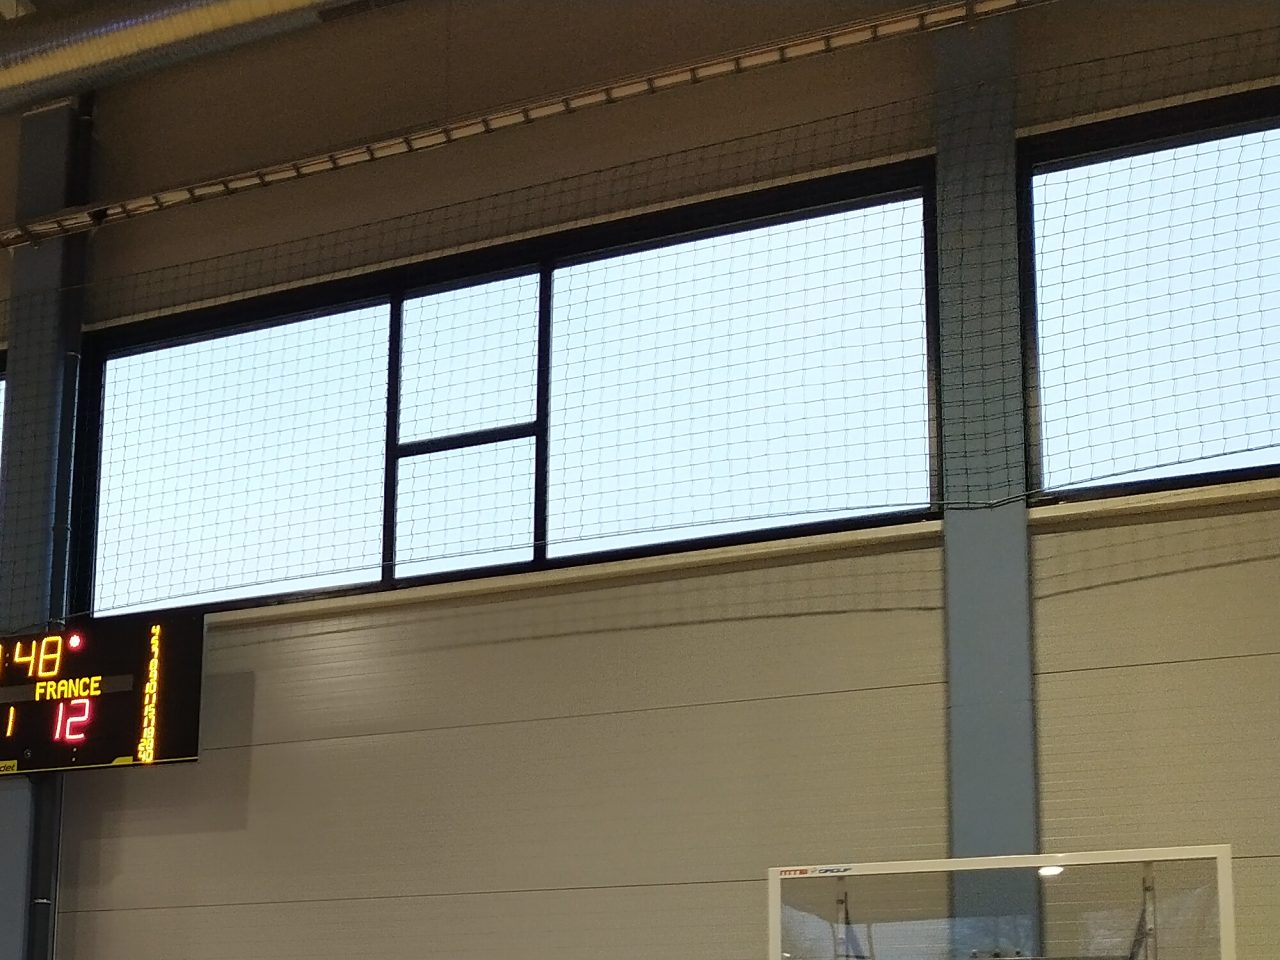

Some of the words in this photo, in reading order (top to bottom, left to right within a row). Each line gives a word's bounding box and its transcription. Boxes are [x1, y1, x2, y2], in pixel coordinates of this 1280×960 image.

[151, 625, 161, 636] 4
[34, 676, 103, 701] FRANCE
[145, 682, 157, 694] 10
[144, 693, 156, 705] 11
[144, 704, 156, 716] 15
[5, 706, 15, 737] 1
[53, 699, 91, 740] 12
[142, 726, 155, 738] 19
[138, 750, 153, 762] 40
